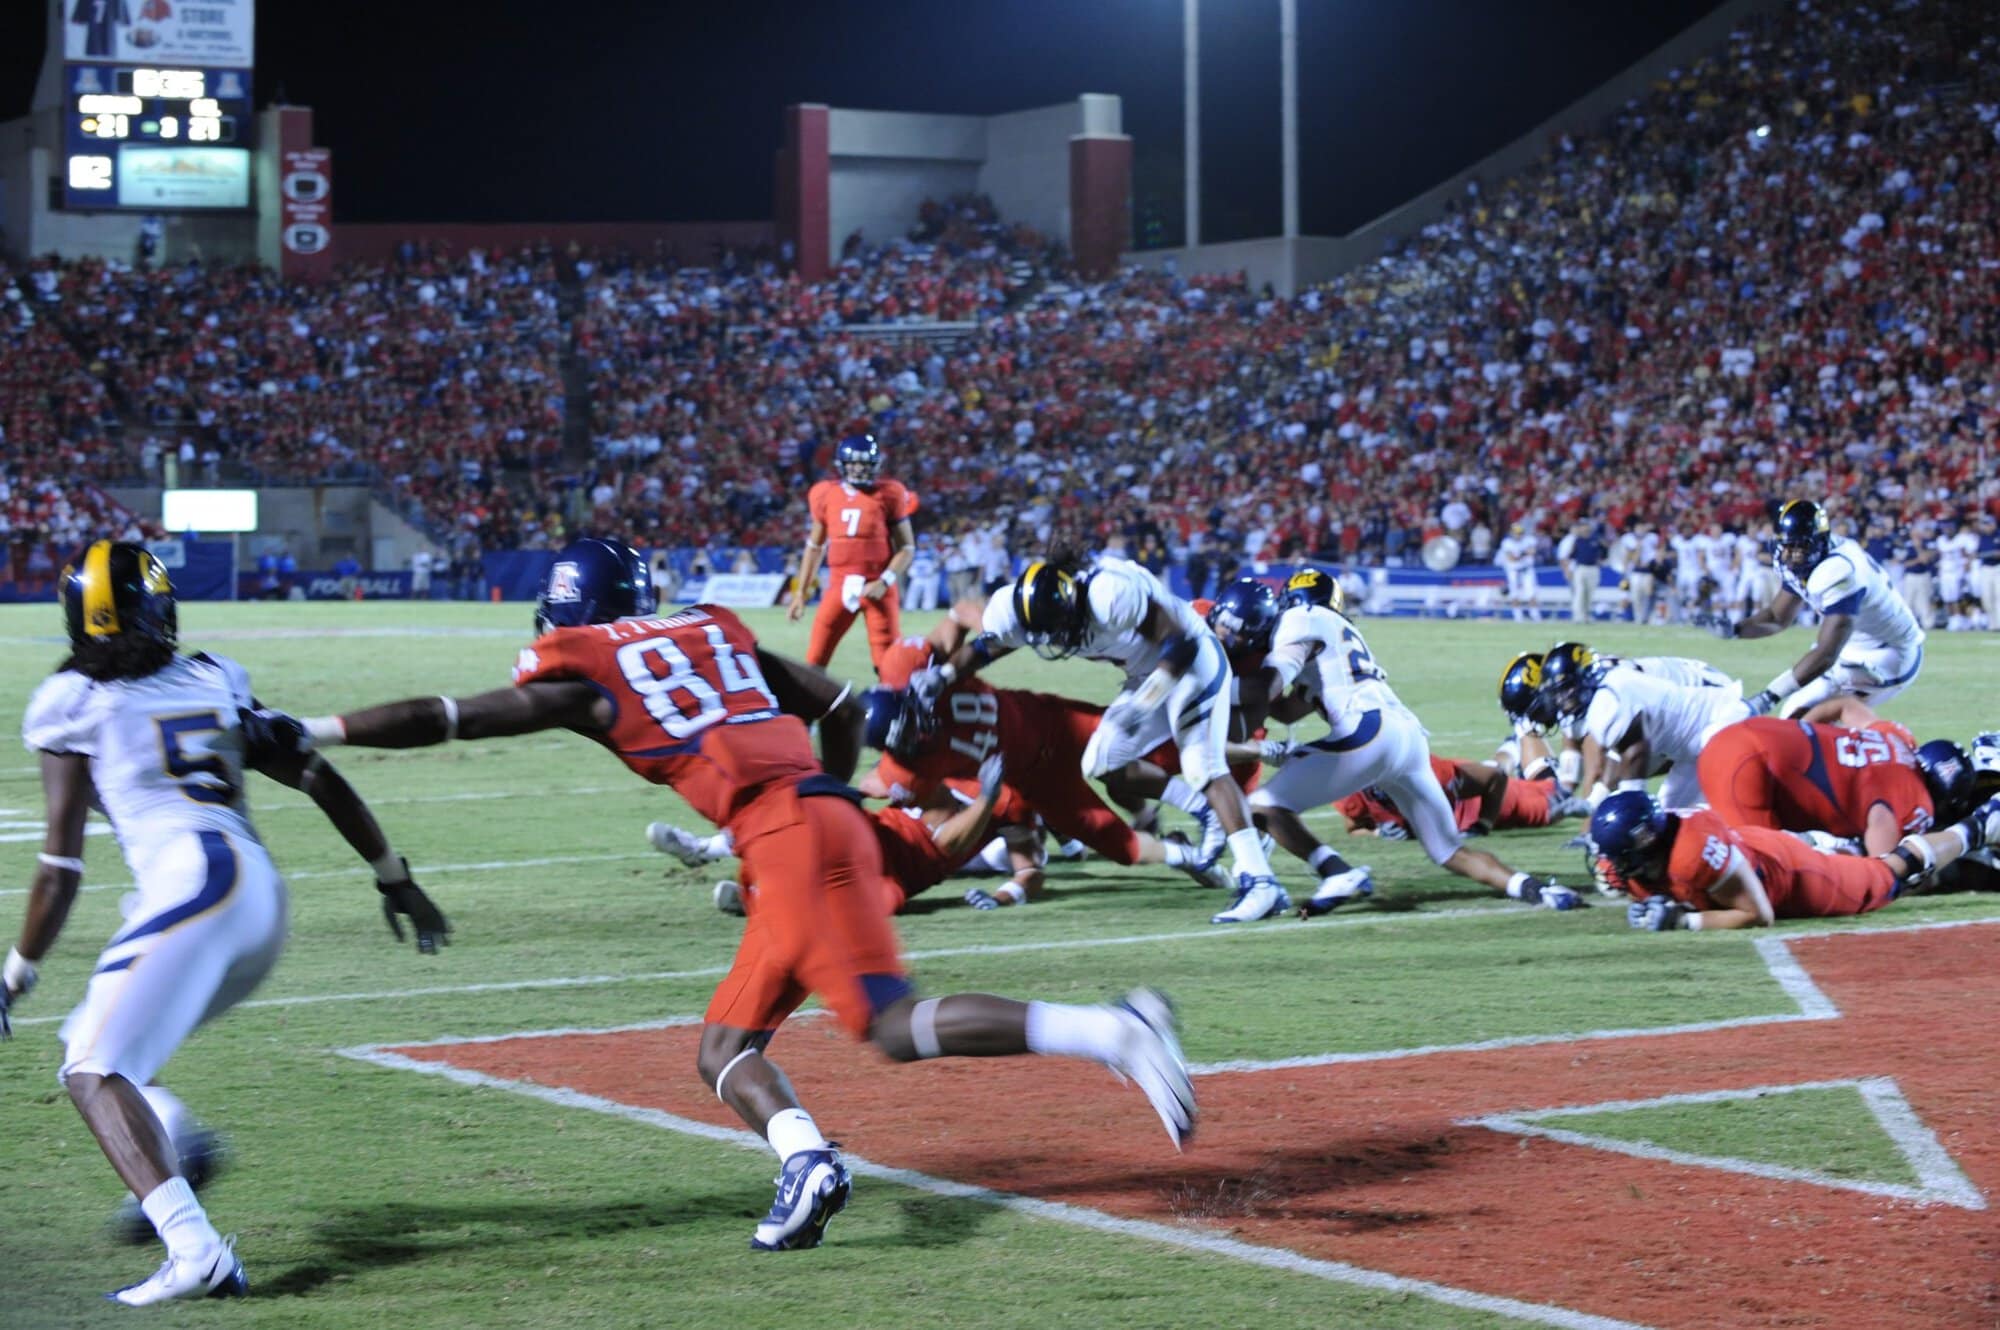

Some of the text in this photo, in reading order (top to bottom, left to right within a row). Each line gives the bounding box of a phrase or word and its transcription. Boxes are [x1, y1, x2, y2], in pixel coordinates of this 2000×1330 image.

[841, 508, 861, 537] 7
[616, 623, 779, 739] 84
[154, 708, 240, 808] 5
[950, 692, 998, 763] 48
